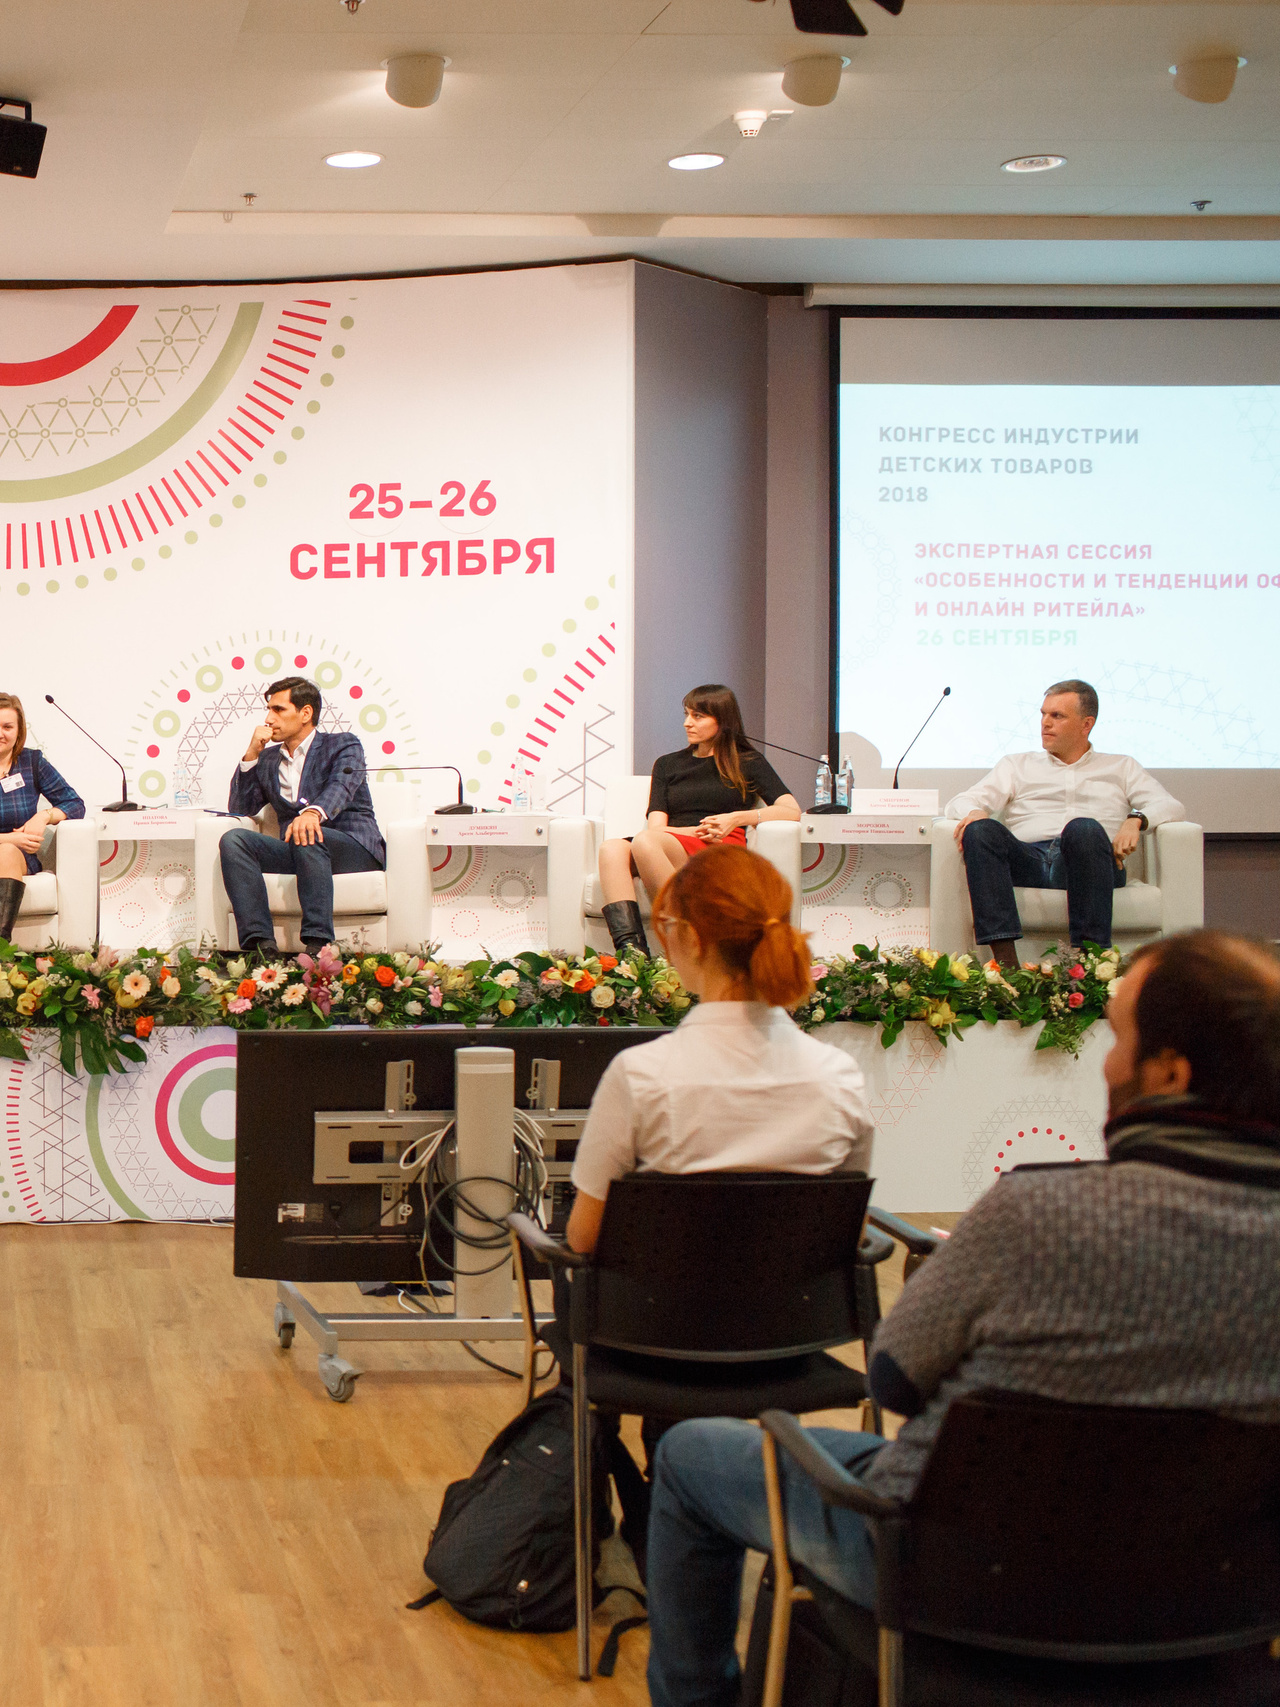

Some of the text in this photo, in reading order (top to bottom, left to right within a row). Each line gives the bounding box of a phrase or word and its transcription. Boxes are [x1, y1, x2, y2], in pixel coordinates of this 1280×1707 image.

[880, 426, 1138, 446] КОНГРЕСС ИНДУСТРИИ
[879, 457, 1093, 475] ДЕТСКИХ ТОВАРОВ
[879, 487, 928, 502] 2018
[290, 537, 555, 580] СЕНТЯБРЯ
[915, 542, 1152, 560] ЭКСПЕРТНАЯ СЕССИЯ
[915, 572, 1084, 588] «ОСОБЕННОСТИ
[1094, 574, 1107, 588] И
[1115, 574, 1247, 590] ТЕНДЕНЦИИ
[915, 598, 1145, 618] И ОНЛАЙН РИТЕЙЛА»
[916, 629, 1078, 647] 26 СЕНТЯБРЯ
